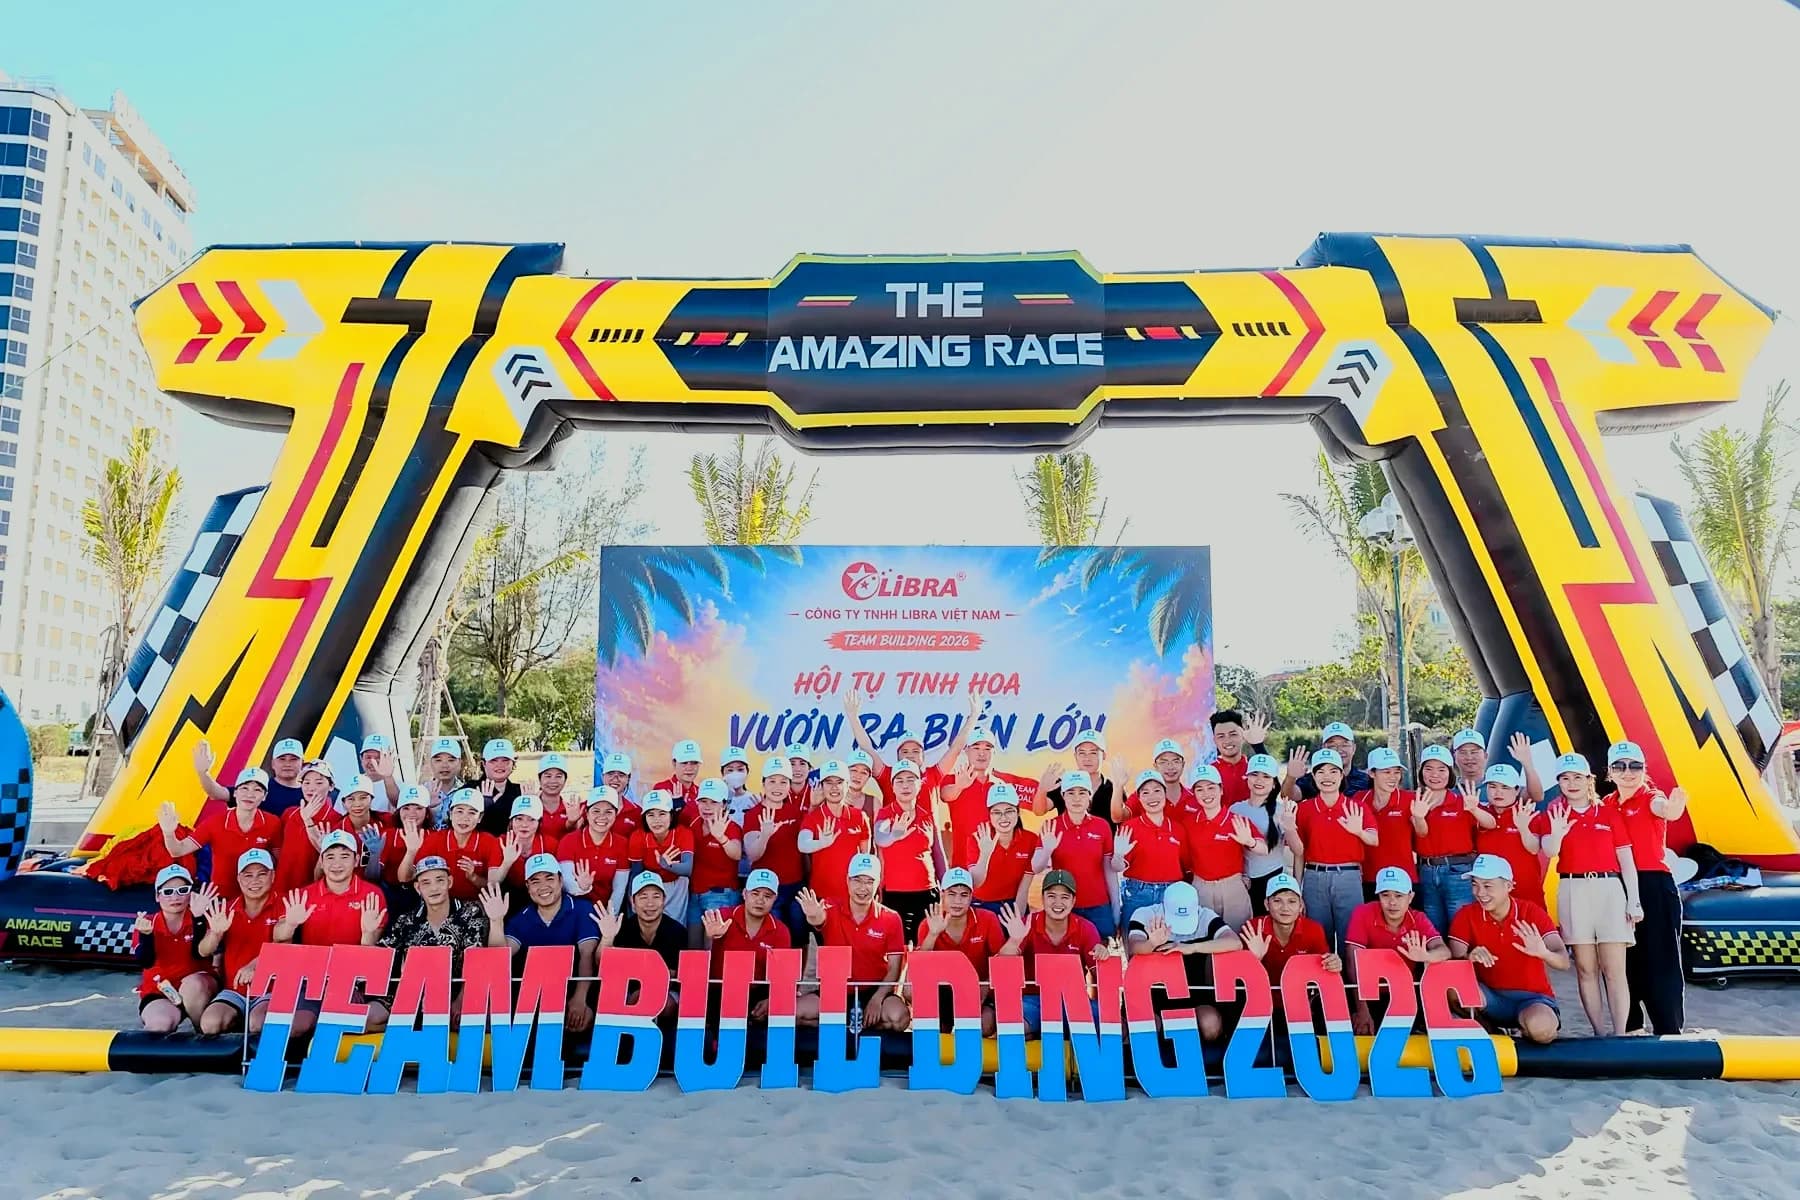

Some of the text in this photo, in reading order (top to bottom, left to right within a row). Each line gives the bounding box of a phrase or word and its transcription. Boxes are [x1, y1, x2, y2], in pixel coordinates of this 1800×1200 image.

[886, 283, 984, 318] THE
[768, 332, 1105, 373] AMAZING RACE
[804, 606, 1001, 622] CÔNG TY TNHH LIBRA VIỆT NAM
[844, 633, 970, 647] TEAM BUILDING 2026
[793, 664, 1021, 700] HỘI TỤ TINH HOA
[851, 712, 908, 751] RA
[923, 699, 1018, 751] BIN
[1014, 783, 1036, 795] TEAM
[5, 918, 72, 932] AMAZING
[18, 934, 64, 948] RACE
[243, 943, 576, 1094] TEAM
[1212, 948, 1505, 1102] 2026
